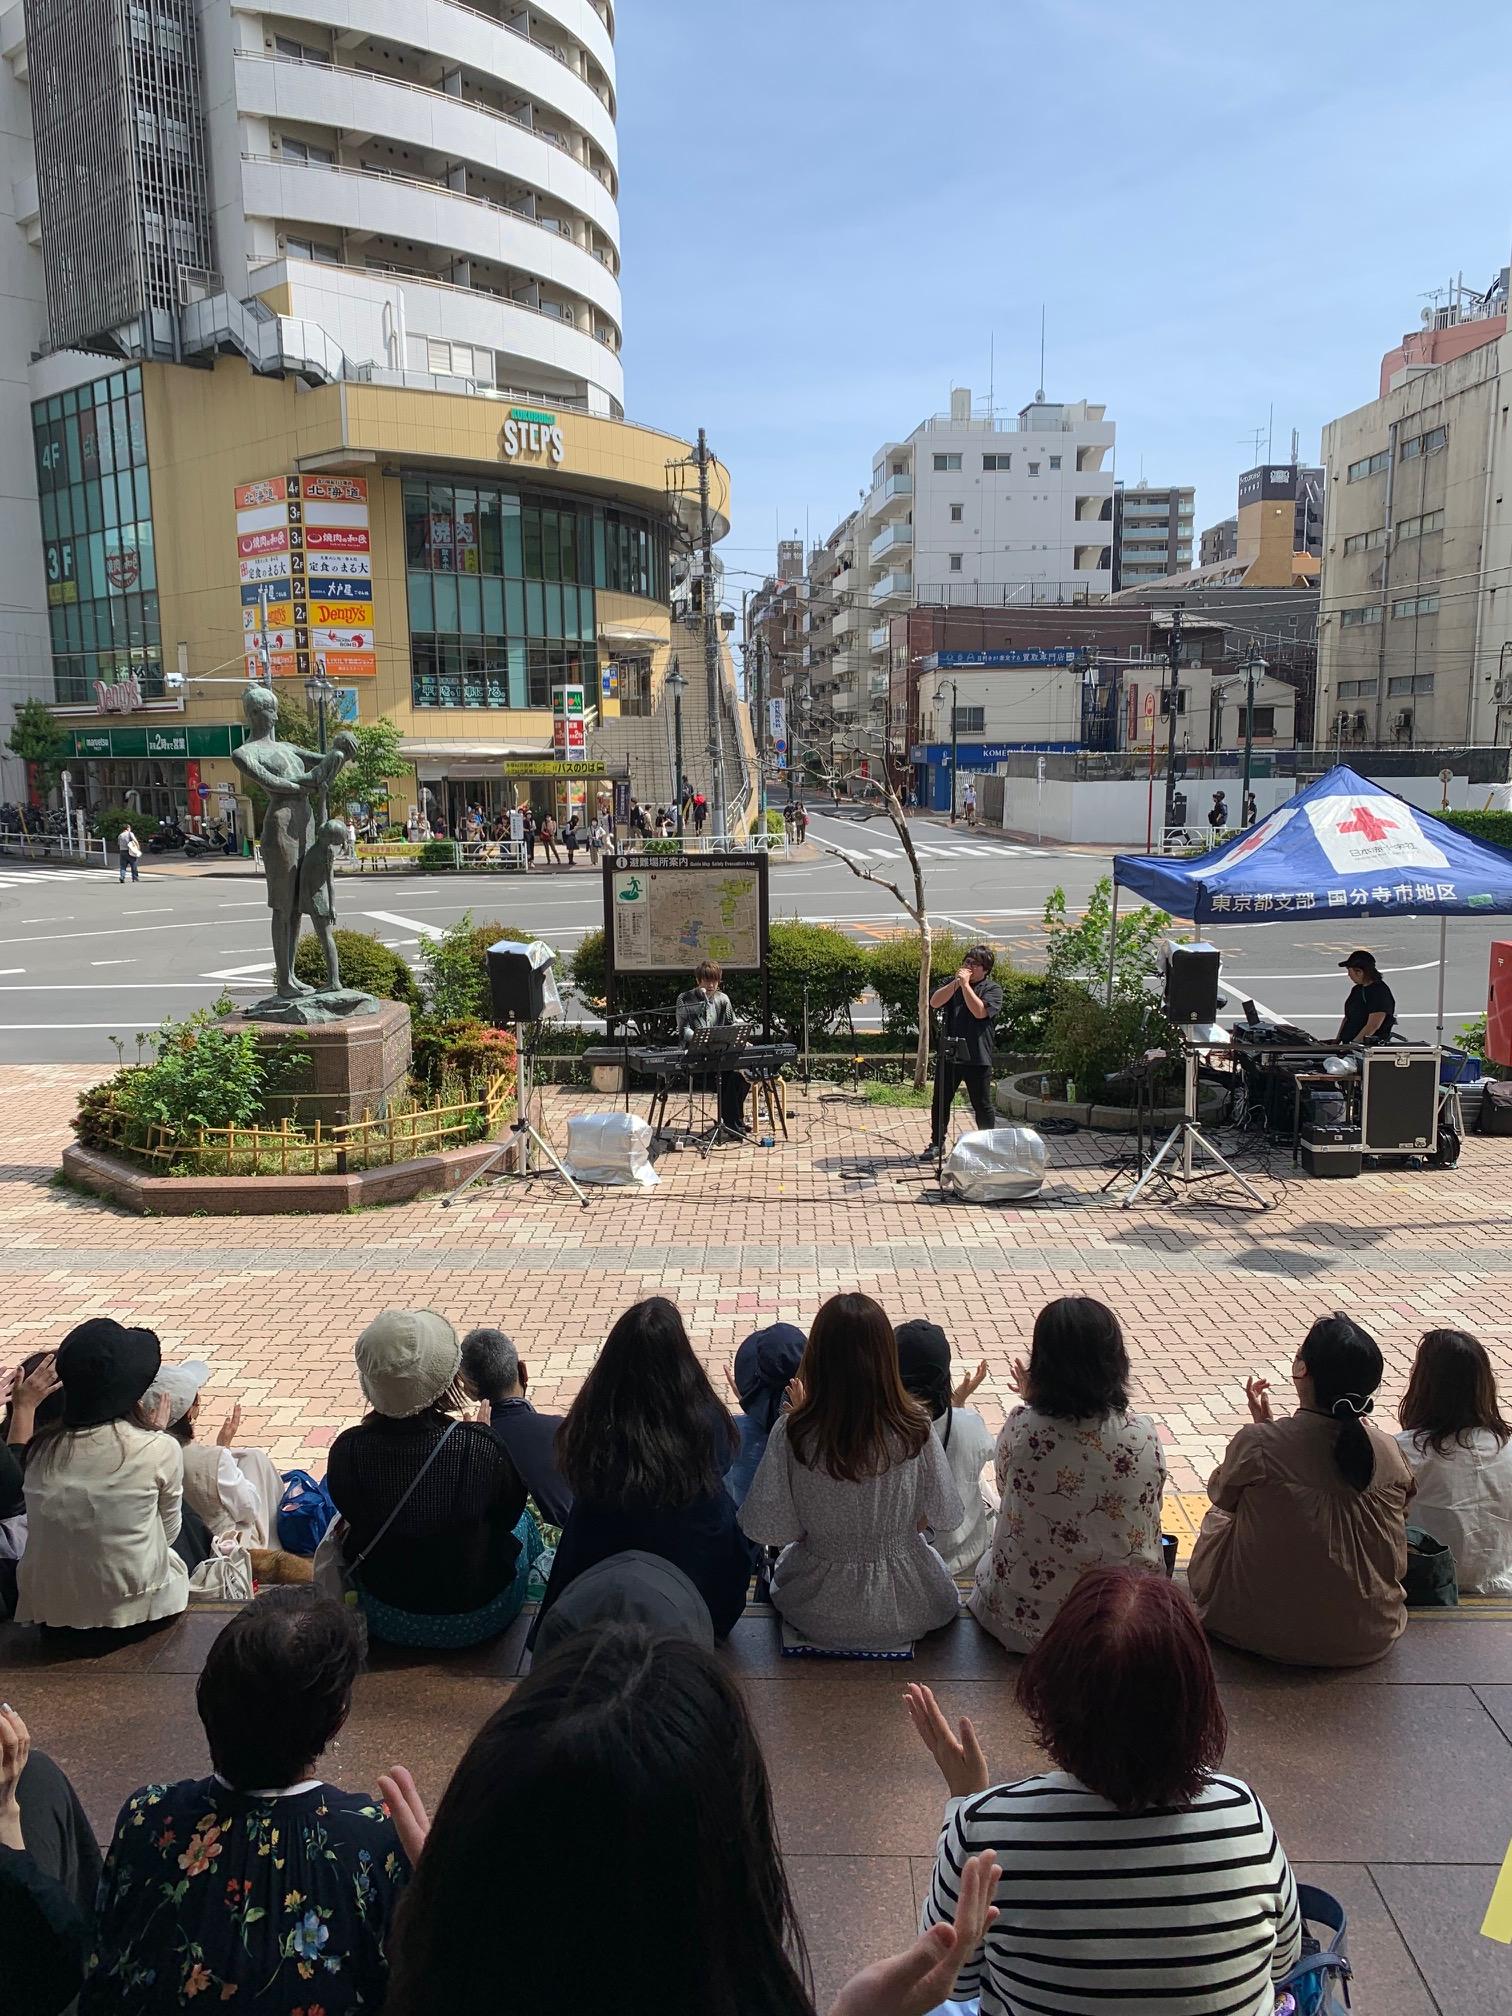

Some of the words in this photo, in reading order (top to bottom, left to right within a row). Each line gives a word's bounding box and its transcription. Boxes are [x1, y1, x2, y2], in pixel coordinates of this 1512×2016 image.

[504, 419, 564, 463] STEP'S
[43, 441, 60, 470] 4F
[288, 481, 299, 493] 4F
[306, 484, 362, 499] 北海道
[244, 488, 276, 503] 北海道
[289, 506, 300, 519] 3F
[291, 532, 302, 544] 3F
[48, 545, 72, 580] 3F
[292, 557, 304, 569] 2F
[309, 562, 369, 574] 定食のまる大
[248, 561, 287, 580] 定食のまる大
[293, 581, 305, 594] 2F
[327, 581, 354, 597] 大戸屋
[295, 607, 306, 619] 2F
[318, 605, 366, 623] Denny's
[297, 632, 305, 644] 1F
[299, 656, 307, 668] 1F
[1023, 652, 1065, 662] 買取専門店
[93, 680, 143, 715] Denny's
[558, 763, 596, 773] バスのりば
[629, 857, 688, 868] 避難場所案内
[1210, 893, 1317, 912] 東京都支部
[1327, 884, 1458, 906] 国分寺市地区
